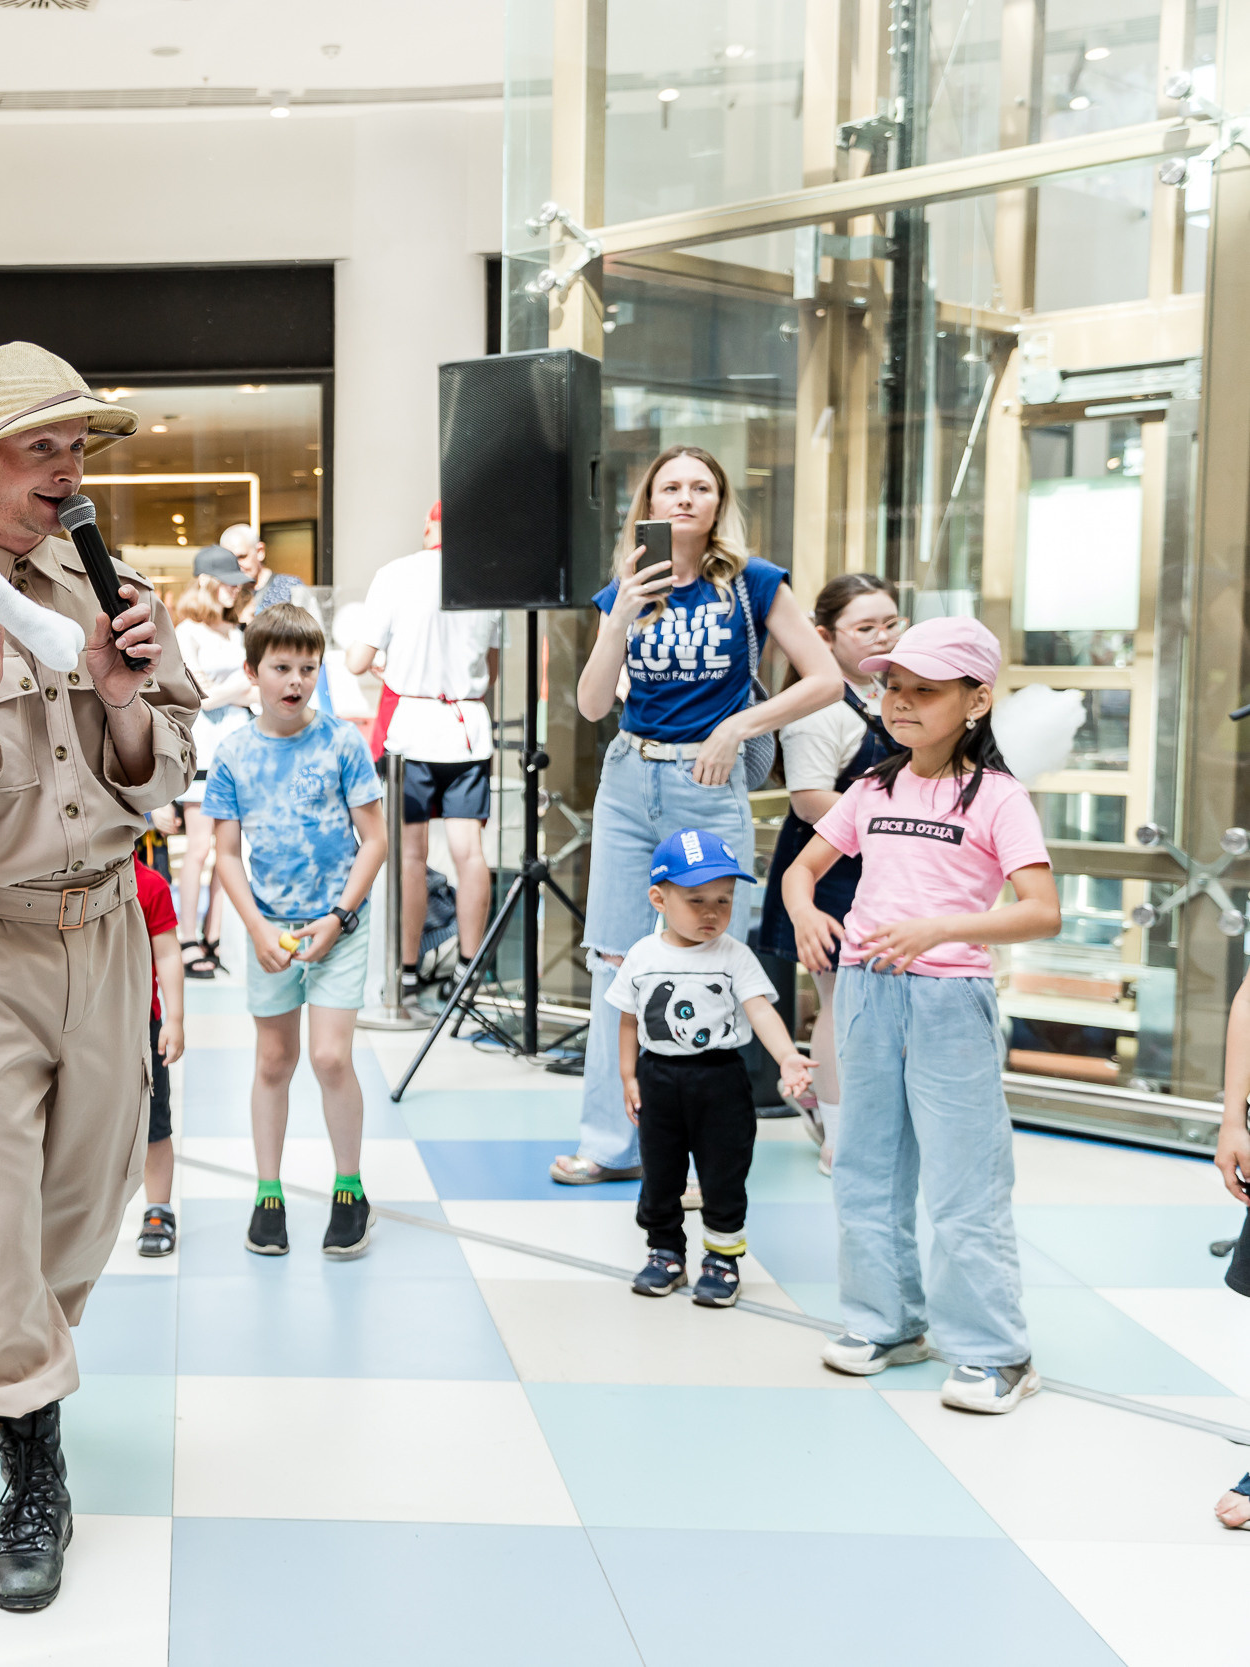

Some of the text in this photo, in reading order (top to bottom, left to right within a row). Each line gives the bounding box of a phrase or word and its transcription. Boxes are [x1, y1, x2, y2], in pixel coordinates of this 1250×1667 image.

[648, 671, 670, 681] YOU
[672, 670, 696, 682] FALL
[915, 823, 955, 840] ОТЦА
